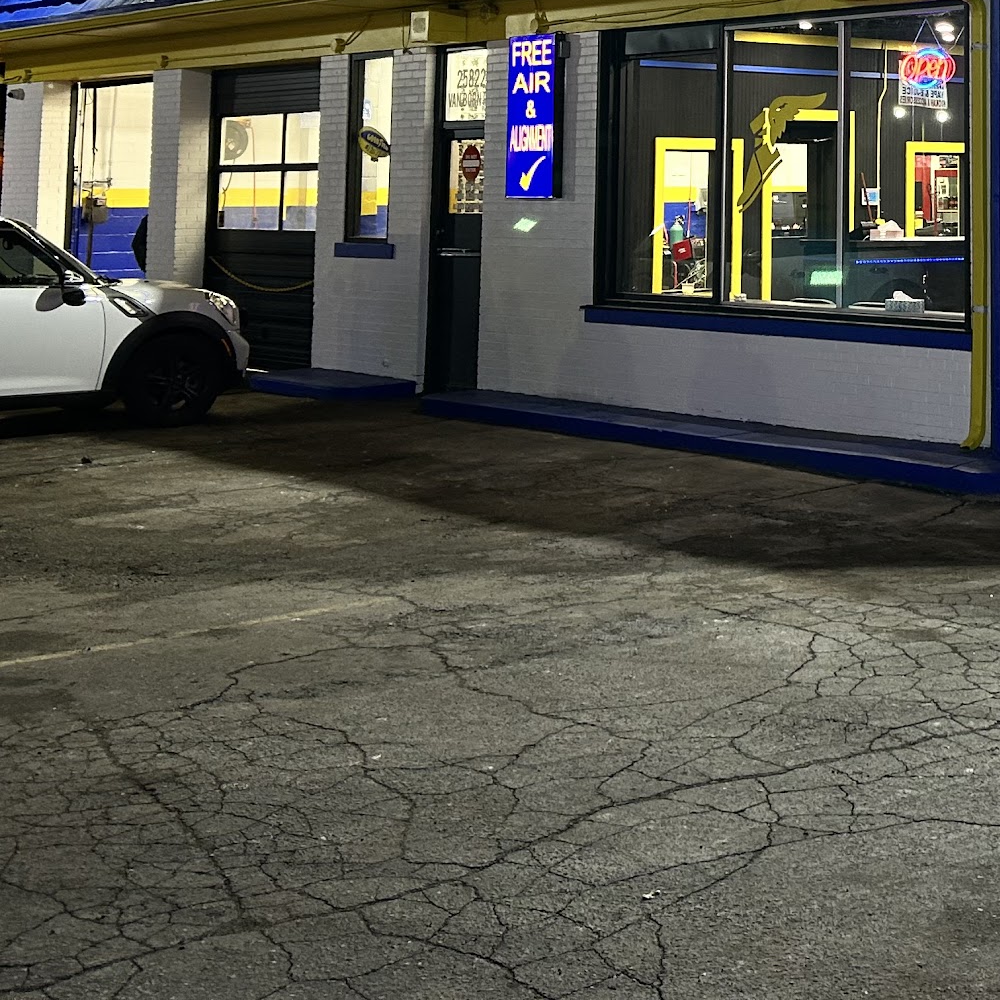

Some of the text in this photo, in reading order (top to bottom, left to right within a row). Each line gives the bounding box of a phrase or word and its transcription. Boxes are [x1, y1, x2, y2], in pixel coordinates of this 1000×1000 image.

[511, 39, 552, 67] FREE
[457, 68, 486, 89] 25822
[512, 71, 551, 94] AIR
[525, 99, 537, 119] &
[510, 124, 554, 152] ALIGNMENT
